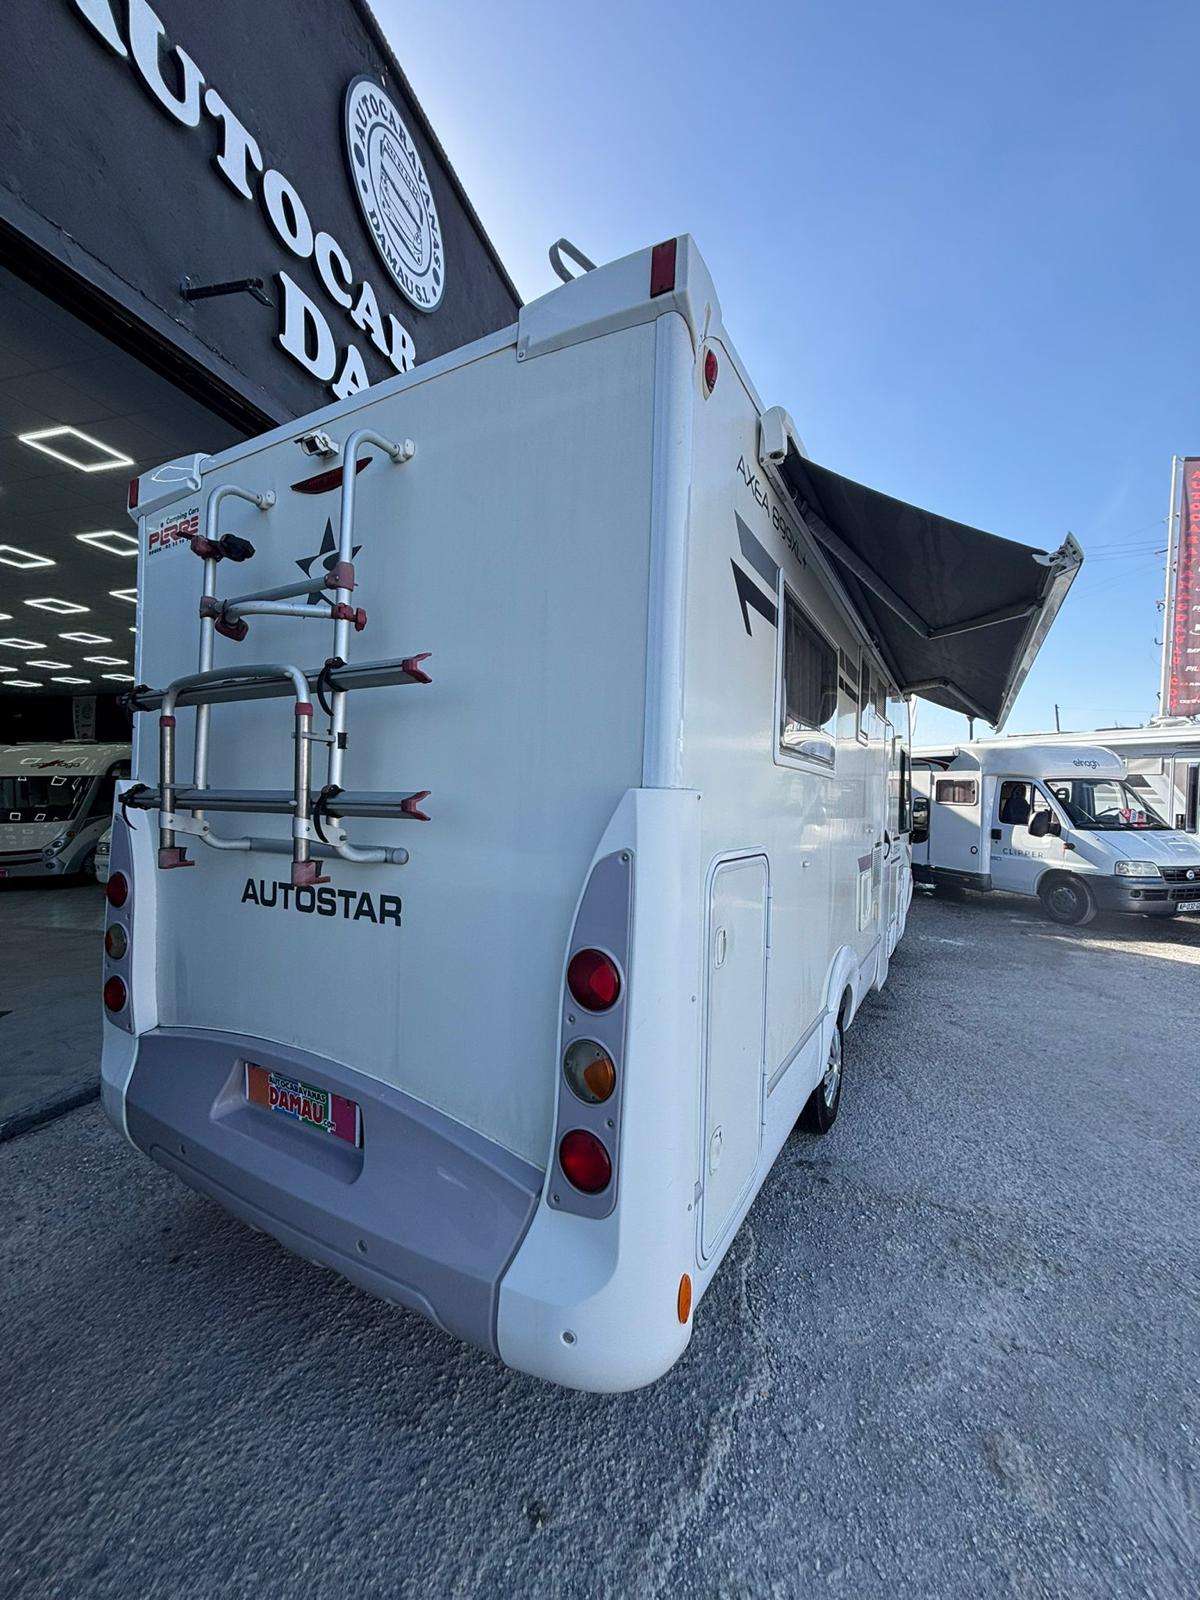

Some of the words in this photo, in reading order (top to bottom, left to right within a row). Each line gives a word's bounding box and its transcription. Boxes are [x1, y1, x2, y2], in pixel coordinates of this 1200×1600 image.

[354, 92, 442, 269] AUTOCARAVANAS
[368, 208, 414, 296] DAMAU
[736, 455, 771, 518] AXEA
[1002, 848, 1044, 858] CLIPPER
[241, 878, 402, 927] AUTOSTAR
